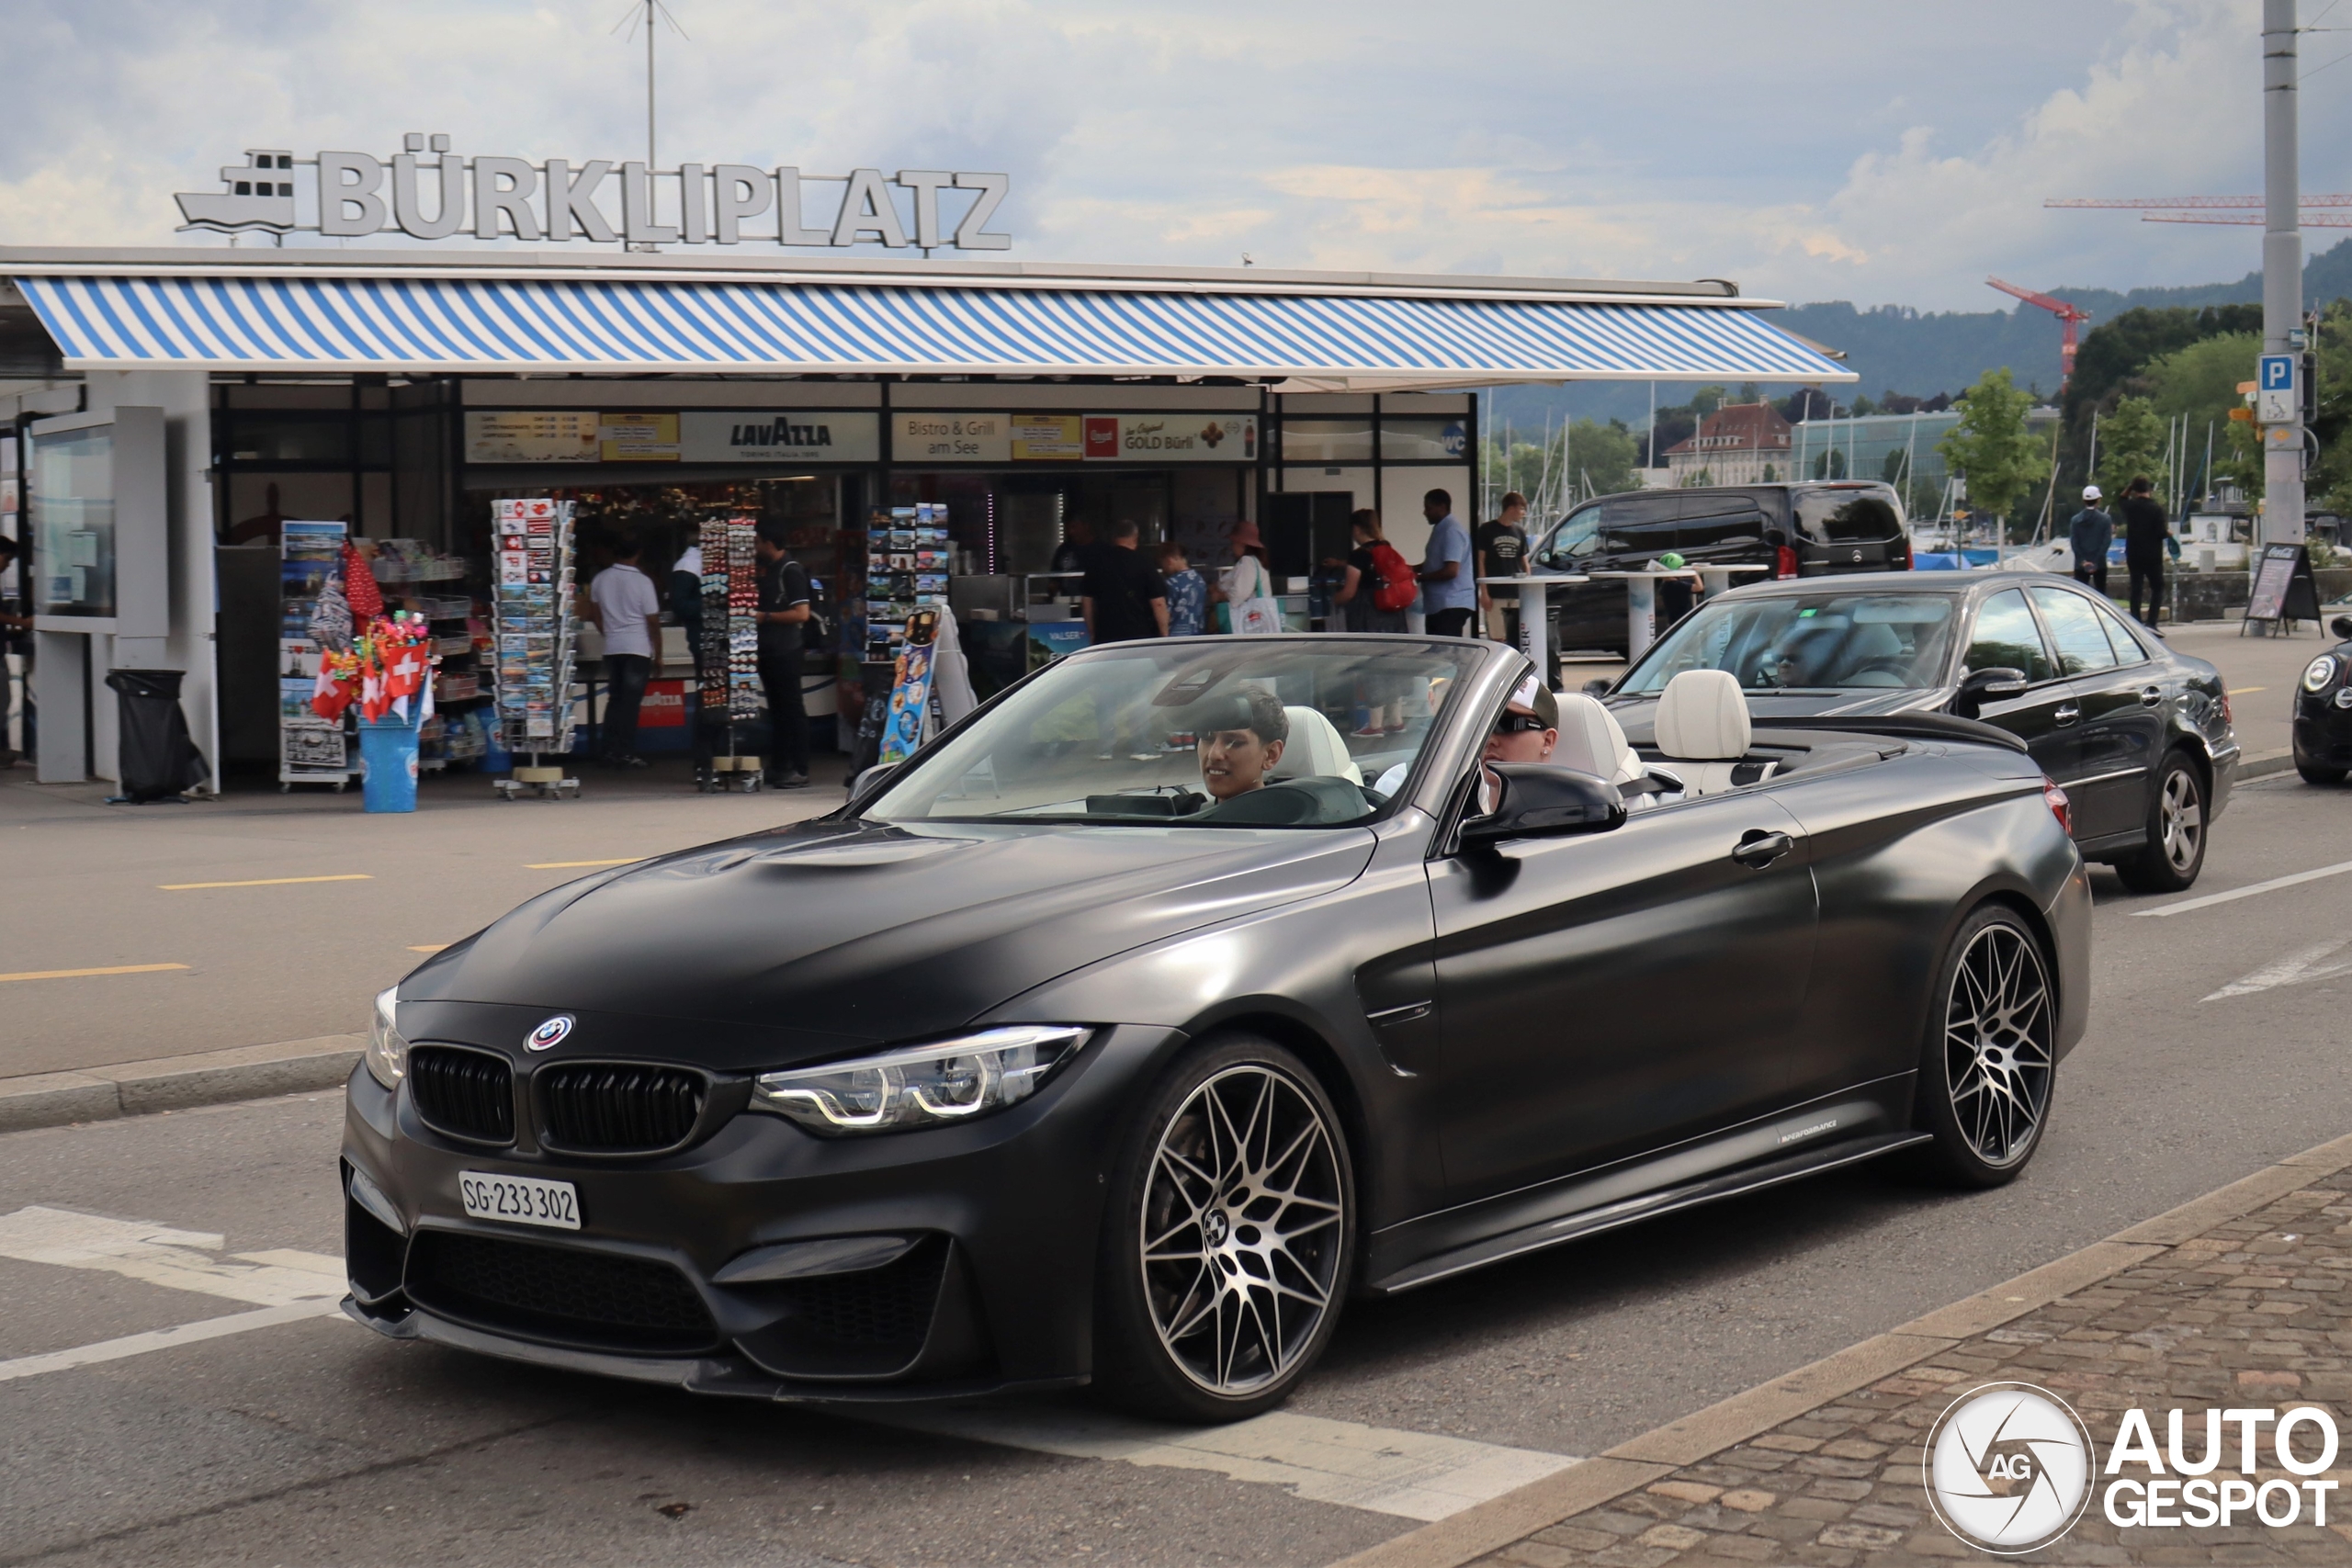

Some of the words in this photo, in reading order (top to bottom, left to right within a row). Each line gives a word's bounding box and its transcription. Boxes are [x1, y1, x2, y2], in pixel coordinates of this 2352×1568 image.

[317, 132, 1012, 251] BÜRKLIPLATZ
[2269, 361, 2286, 387] P
[730, 417, 831, 446] LAVAZZA
[909, 421, 948, 435] Bistro
[953, 422, 963, 435] &
[967, 421, 995, 435] Grill
[928, 444, 950, 455] am
[954, 440, 979, 455] See
[1125, 436, 1161, 449] GOLD
[1164, 436, 1193, 449] Bürli
[1442, 435, 1465, 451] WC
[1048, 631, 1080, 641] VALSER
